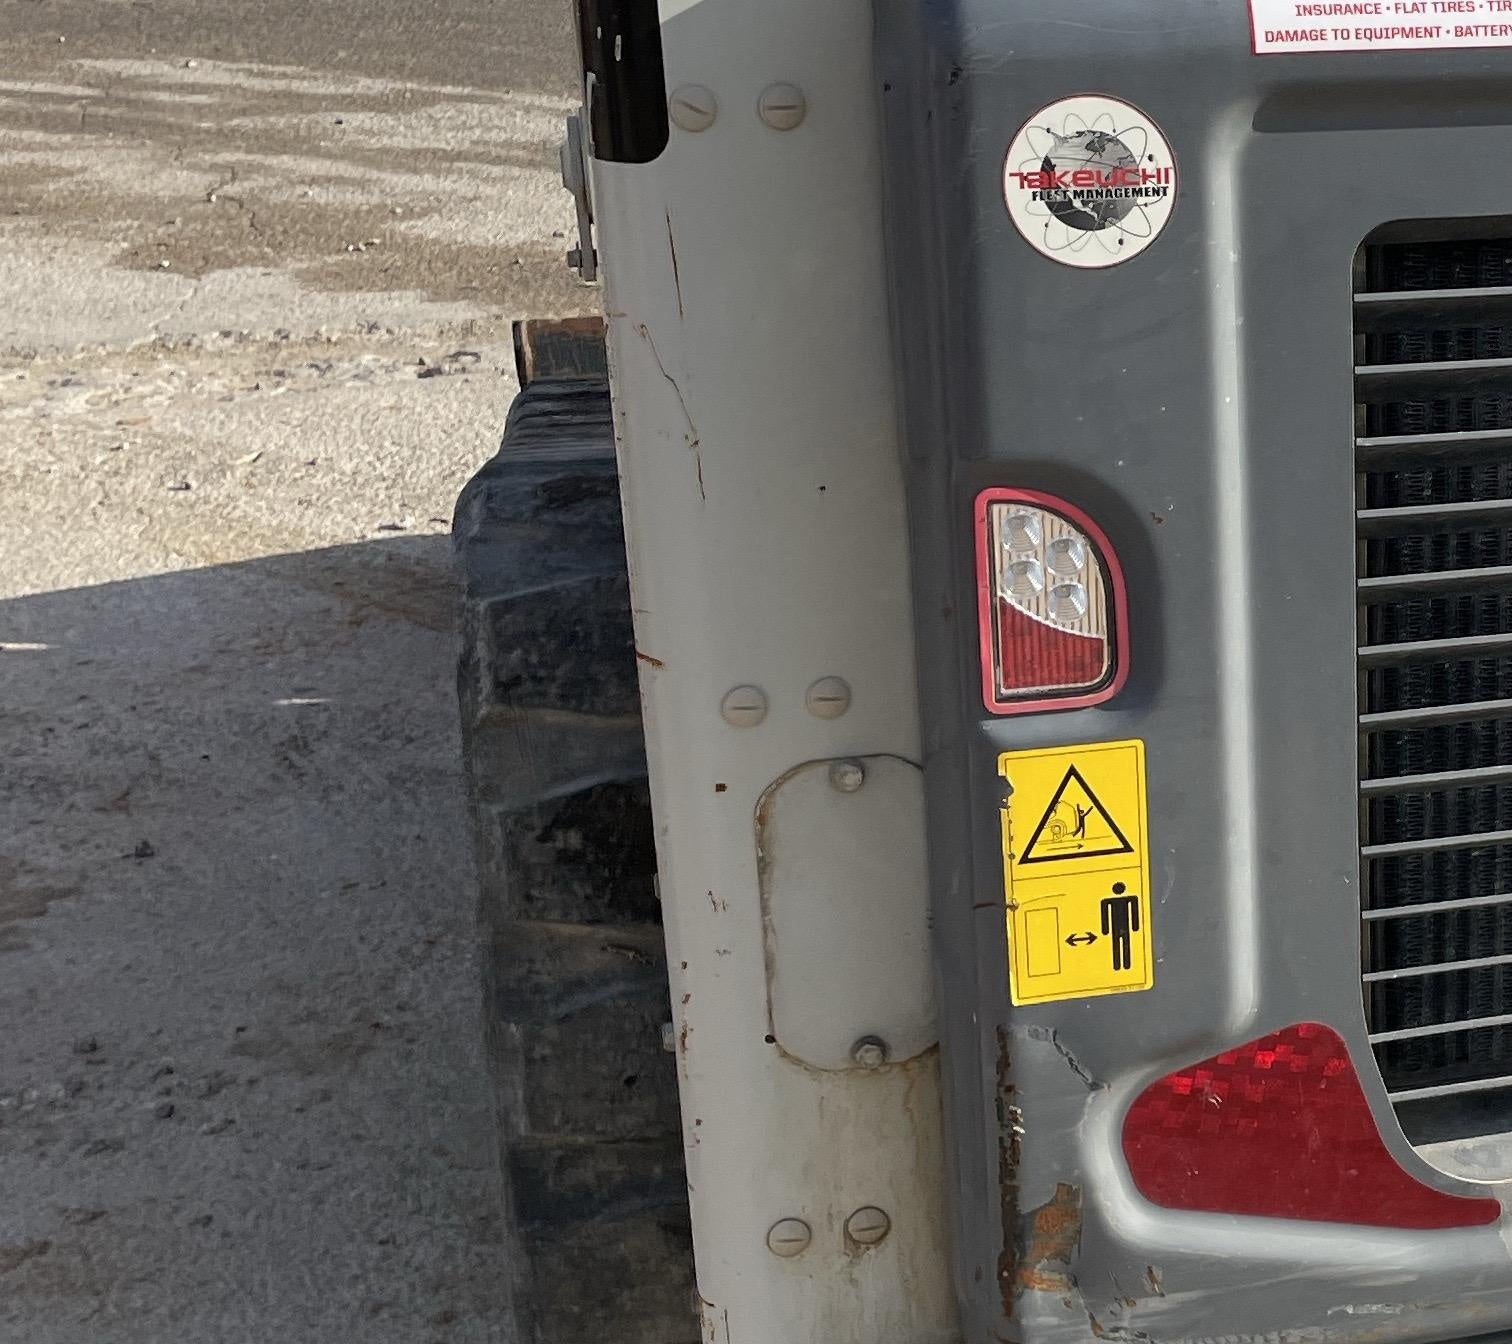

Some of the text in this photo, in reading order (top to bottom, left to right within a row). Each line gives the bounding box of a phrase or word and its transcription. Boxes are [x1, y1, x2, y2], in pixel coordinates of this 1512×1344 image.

[1295, 2, 1382, 17] INSURANCE
[1394, 1, 1428, 14] FLAT
[1431, 0, 1476, 13] TIRES
[1265, 28, 1328, 43] DAMAGE
[1331, 27, 1350, 41] TO
[1355, 26, 1442, 42] EQUIPMENT
[1073, 186, 1168, 200] MANAGEMENT
